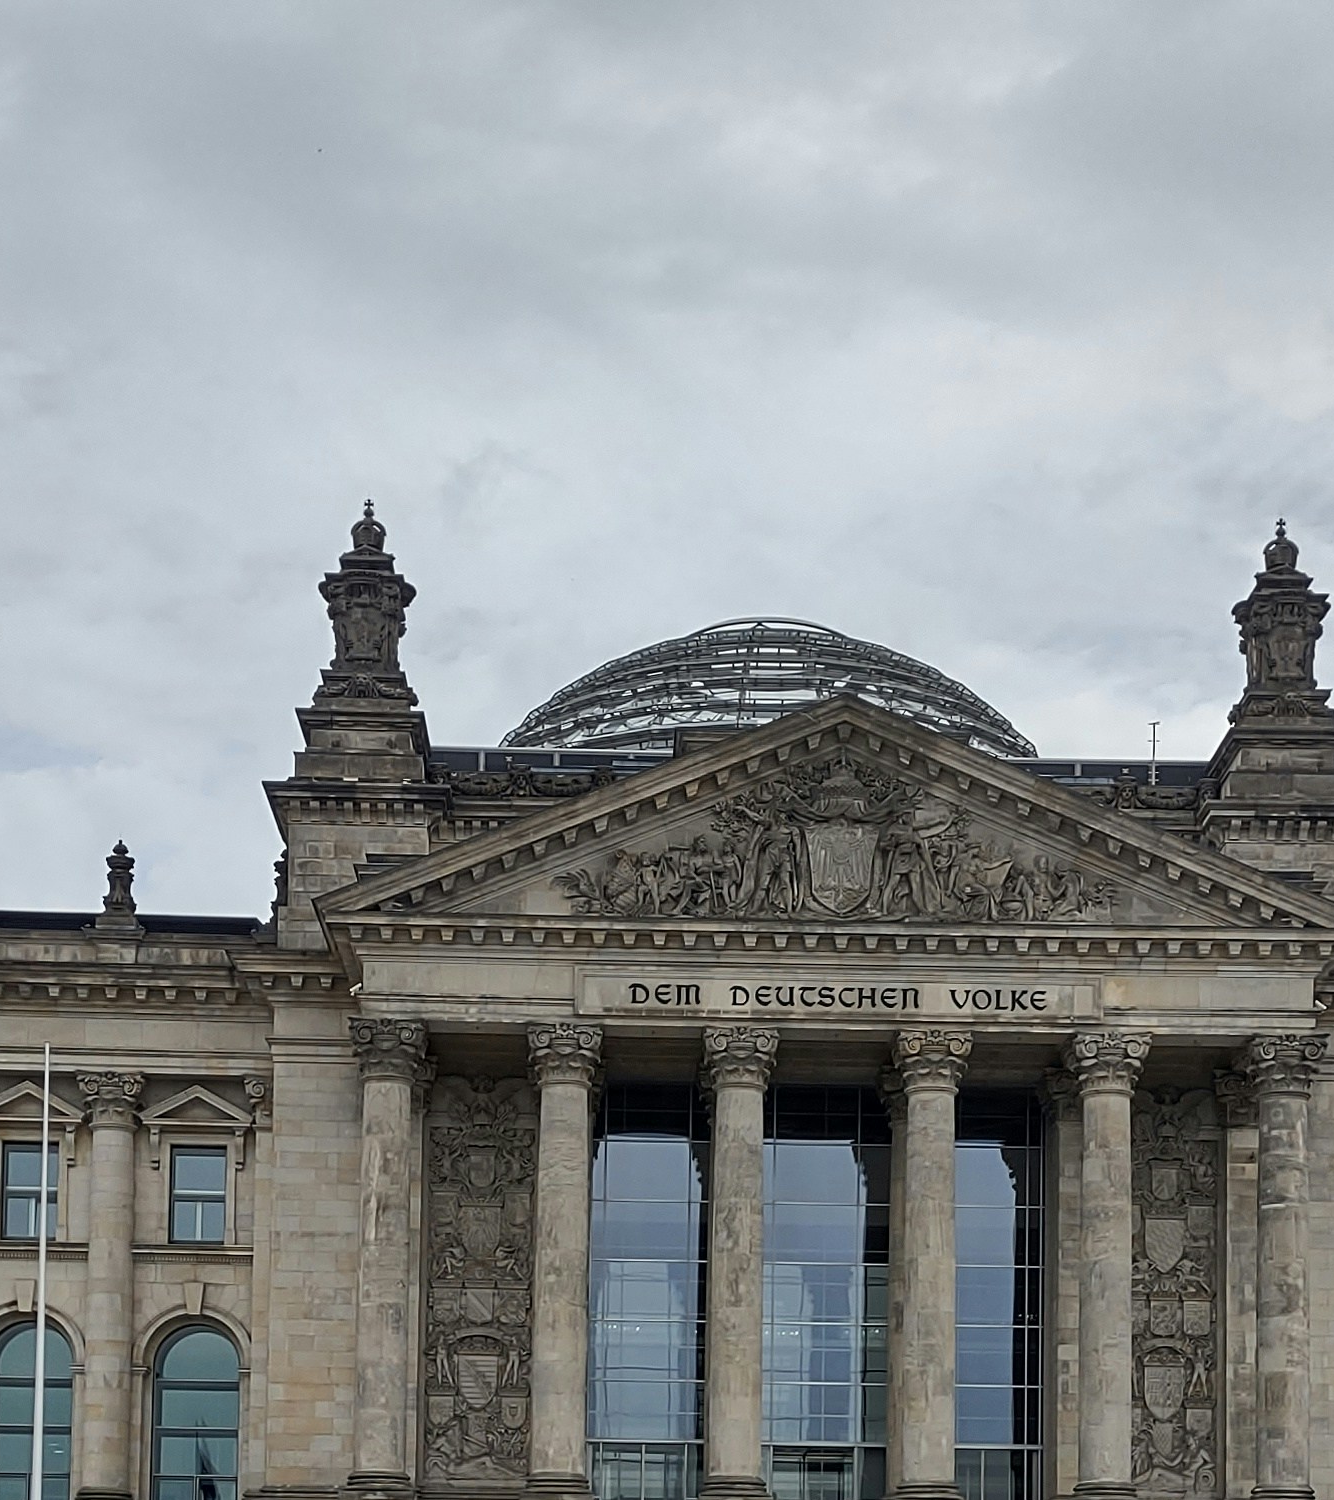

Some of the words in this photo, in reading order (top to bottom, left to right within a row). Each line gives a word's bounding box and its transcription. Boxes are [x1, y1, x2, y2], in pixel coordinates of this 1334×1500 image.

[628, 983, 701, 1006] DEM
[729, 985, 920, 1010] DEUTSCHEN
[949, 989, 1048, 1012] VOLKE
